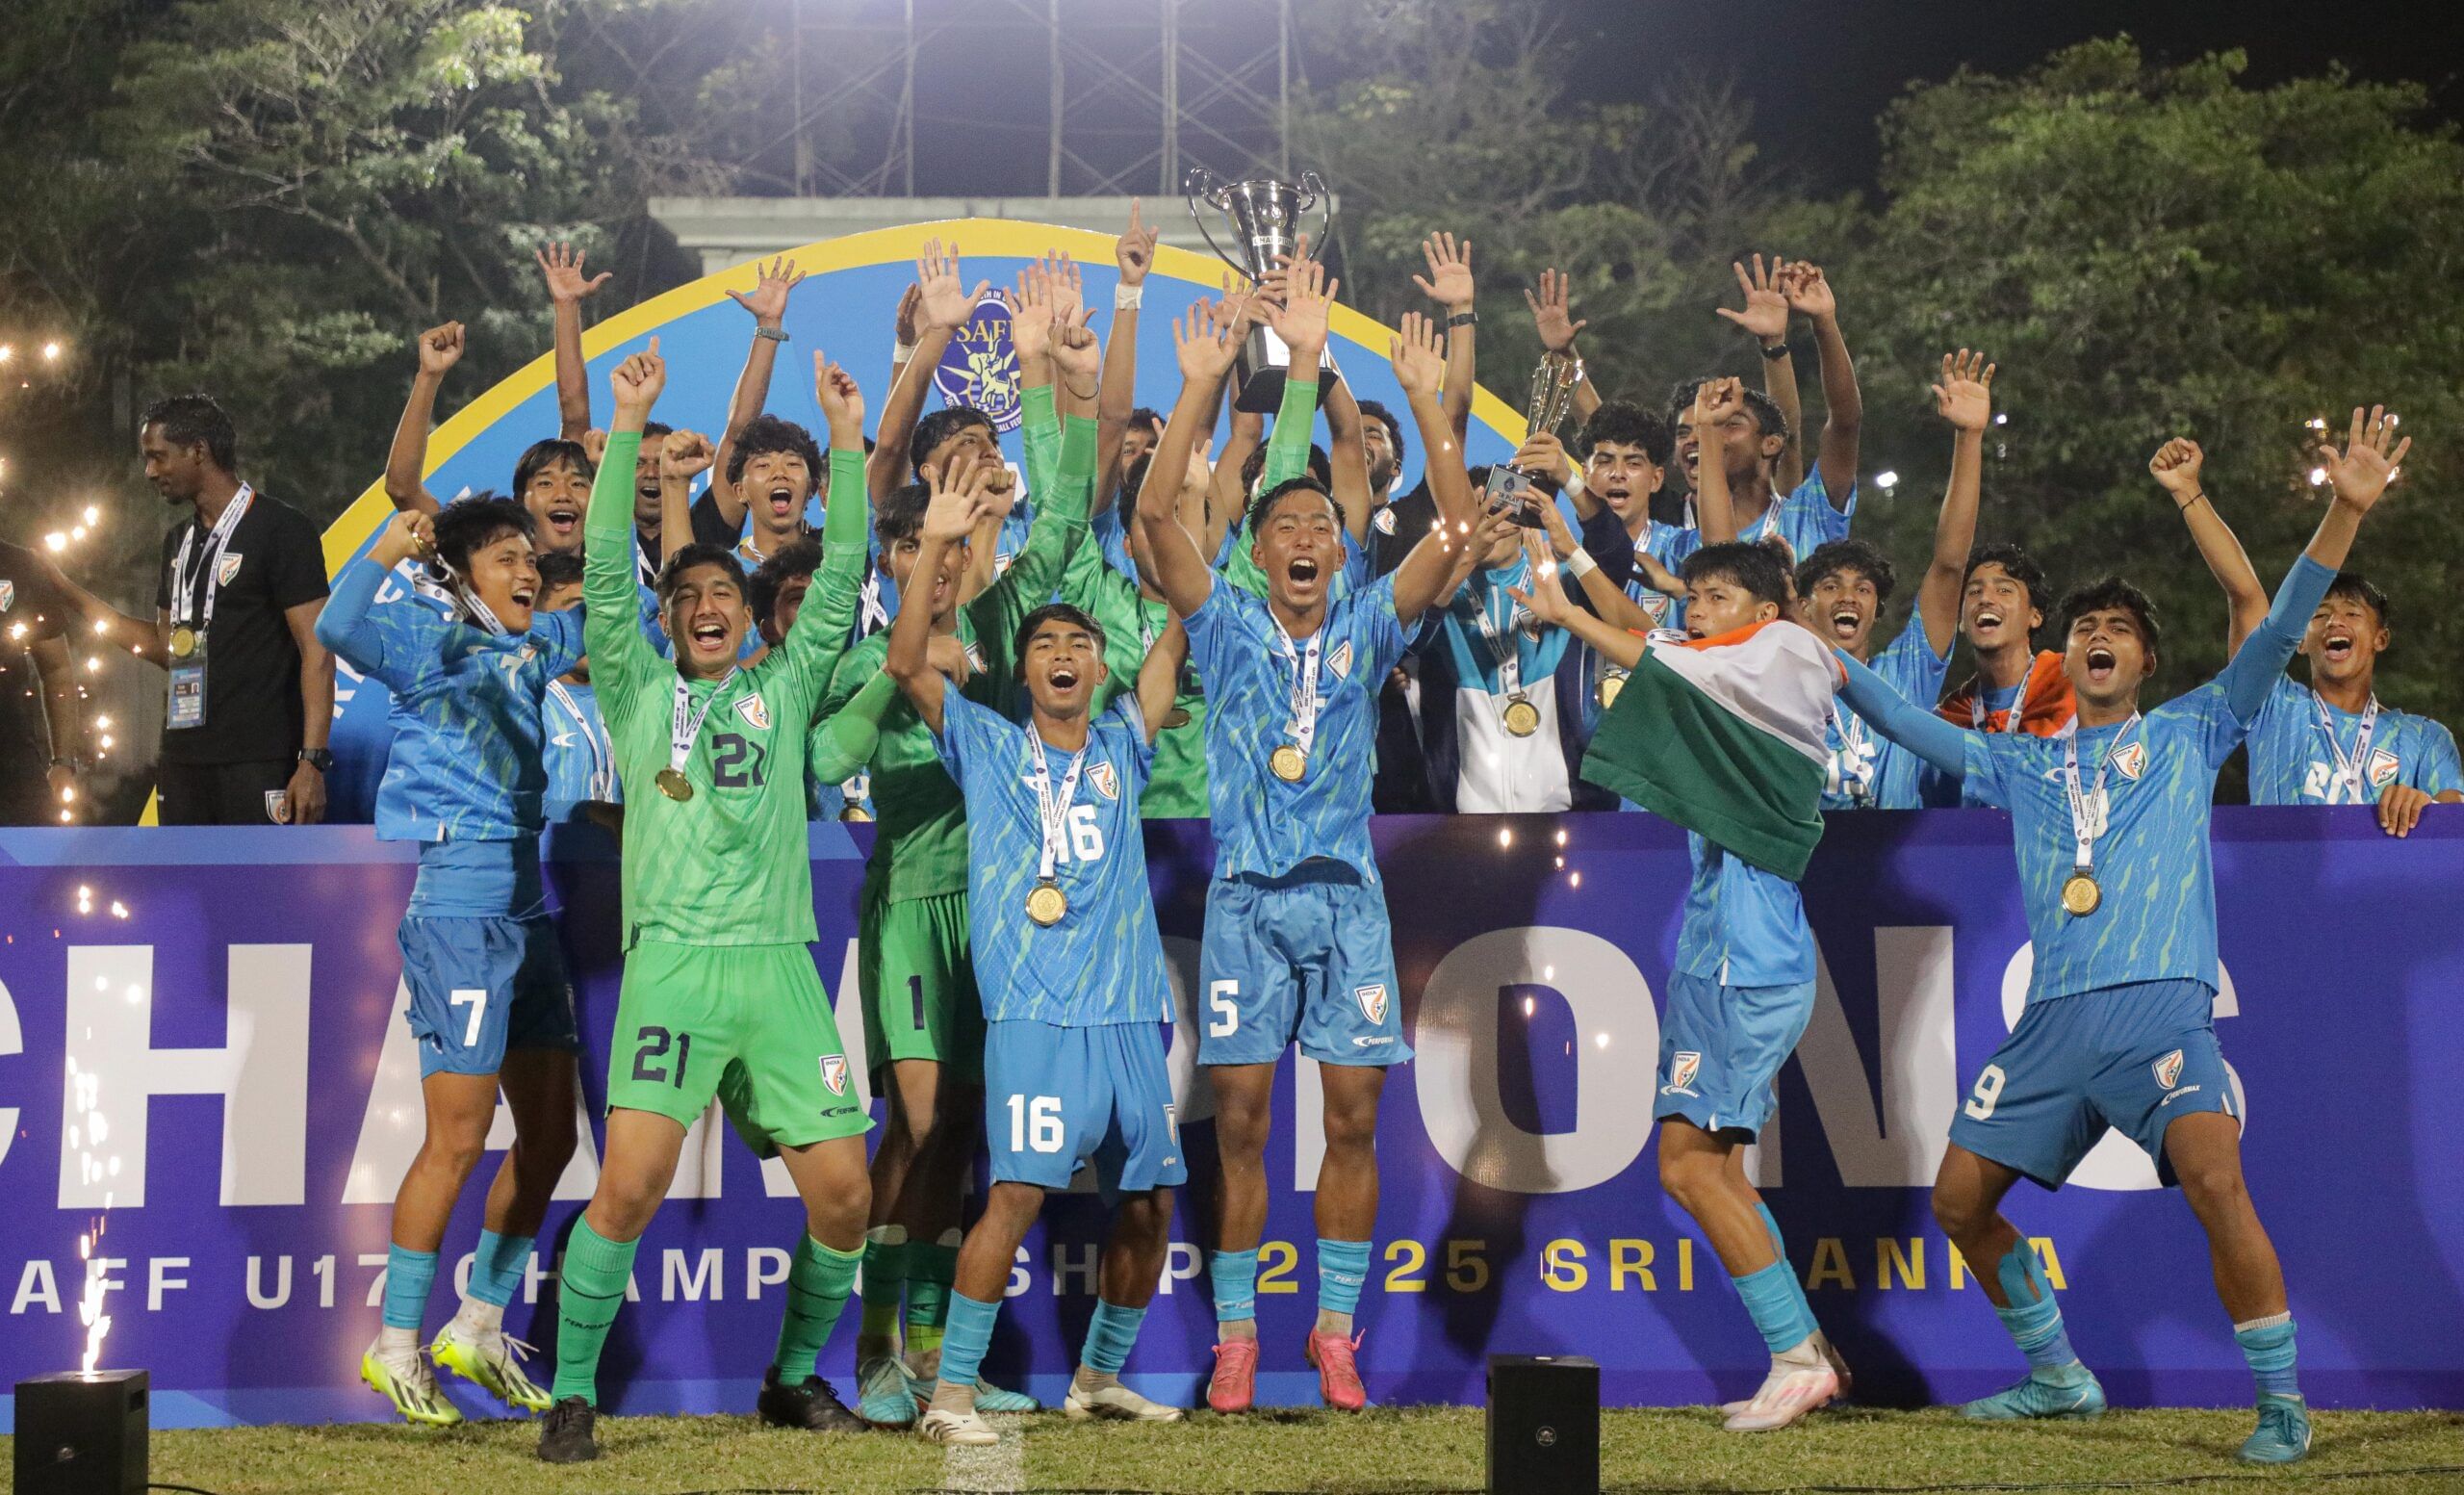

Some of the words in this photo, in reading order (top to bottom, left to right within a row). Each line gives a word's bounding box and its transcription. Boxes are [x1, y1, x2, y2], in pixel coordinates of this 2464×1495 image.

[957, 320, 1014, 343] SAF
[500, 655, 526, 692] 7
[1332, 652, 1347, 665] INDIA
[712, 734, 765, 787] 21
[450, 990, 487, 1046] 7
[907, 975, 924, 1030] 1
[1210, 980, 1238, 1037] 5
[632, 1026, 690, 1089] 21
[1964, 1064, 2006, 1121] 9
[1008, 1095, 1065, 1152] 16
[10, 1257, 191, 1314] AFF
[1257, 1240, 1489, 1293] 225
[1543, 1238, 1693, 1292] SRI
